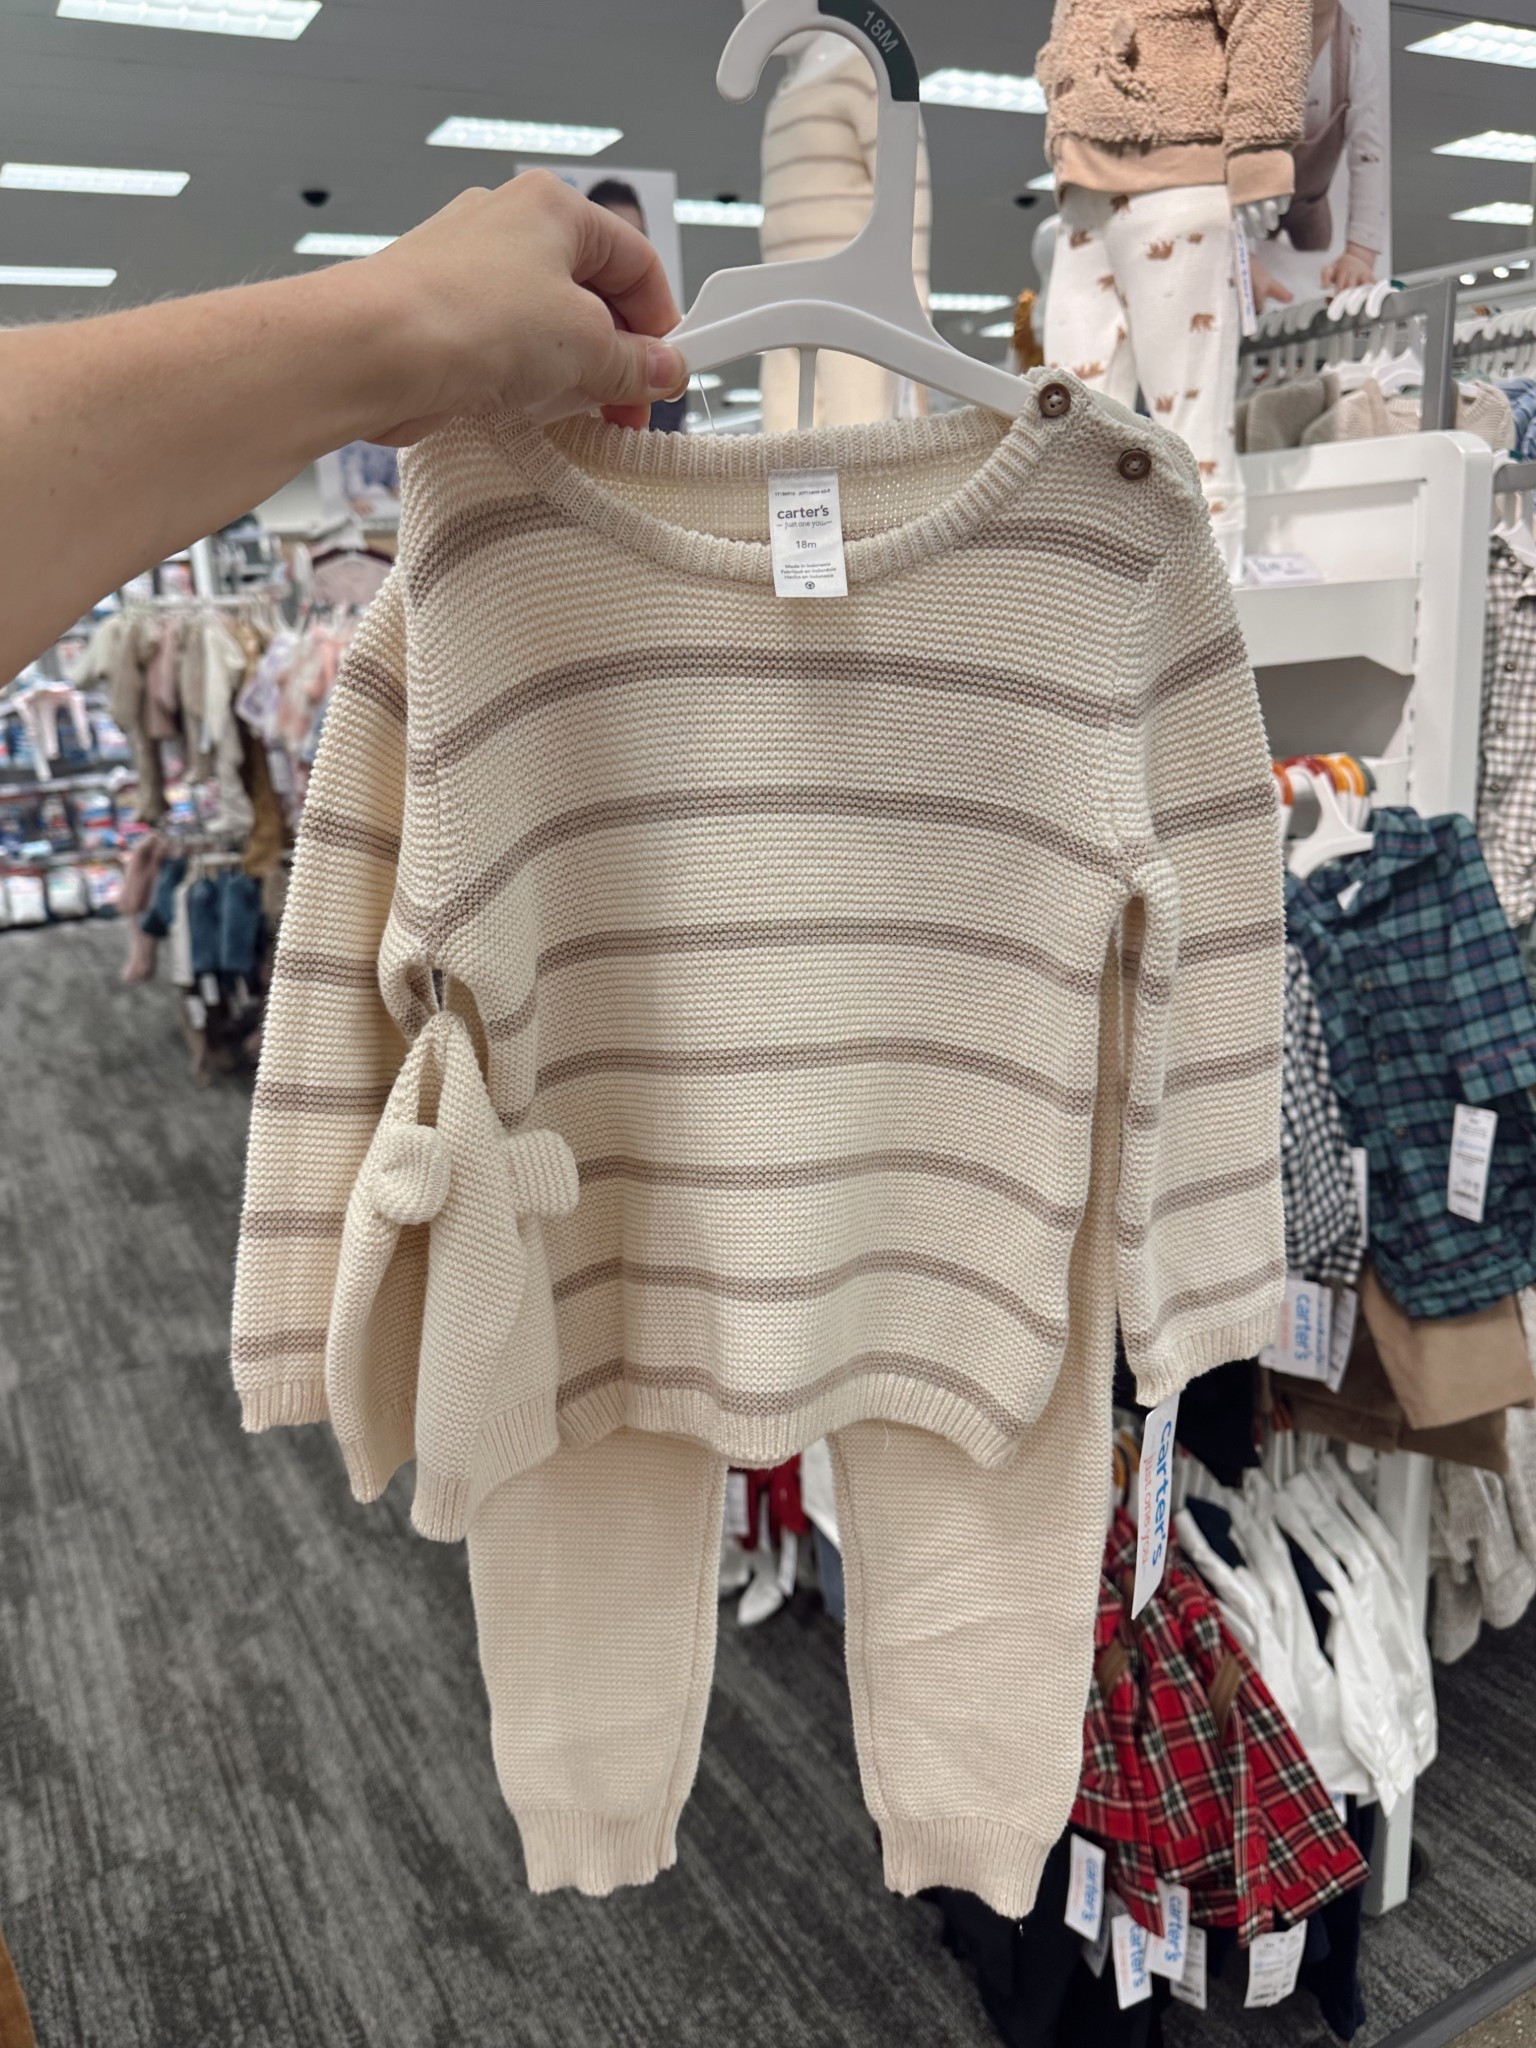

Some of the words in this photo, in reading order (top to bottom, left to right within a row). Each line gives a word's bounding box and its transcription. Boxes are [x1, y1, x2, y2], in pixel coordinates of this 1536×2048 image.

[864, 10, 899, 53] 18M
[777, 505, 830, 520] carter's
[784, 521, 798, 530] just
[795, 540, 817, 549] 18m
[1152, 1420, 1172, 1567] carter's
